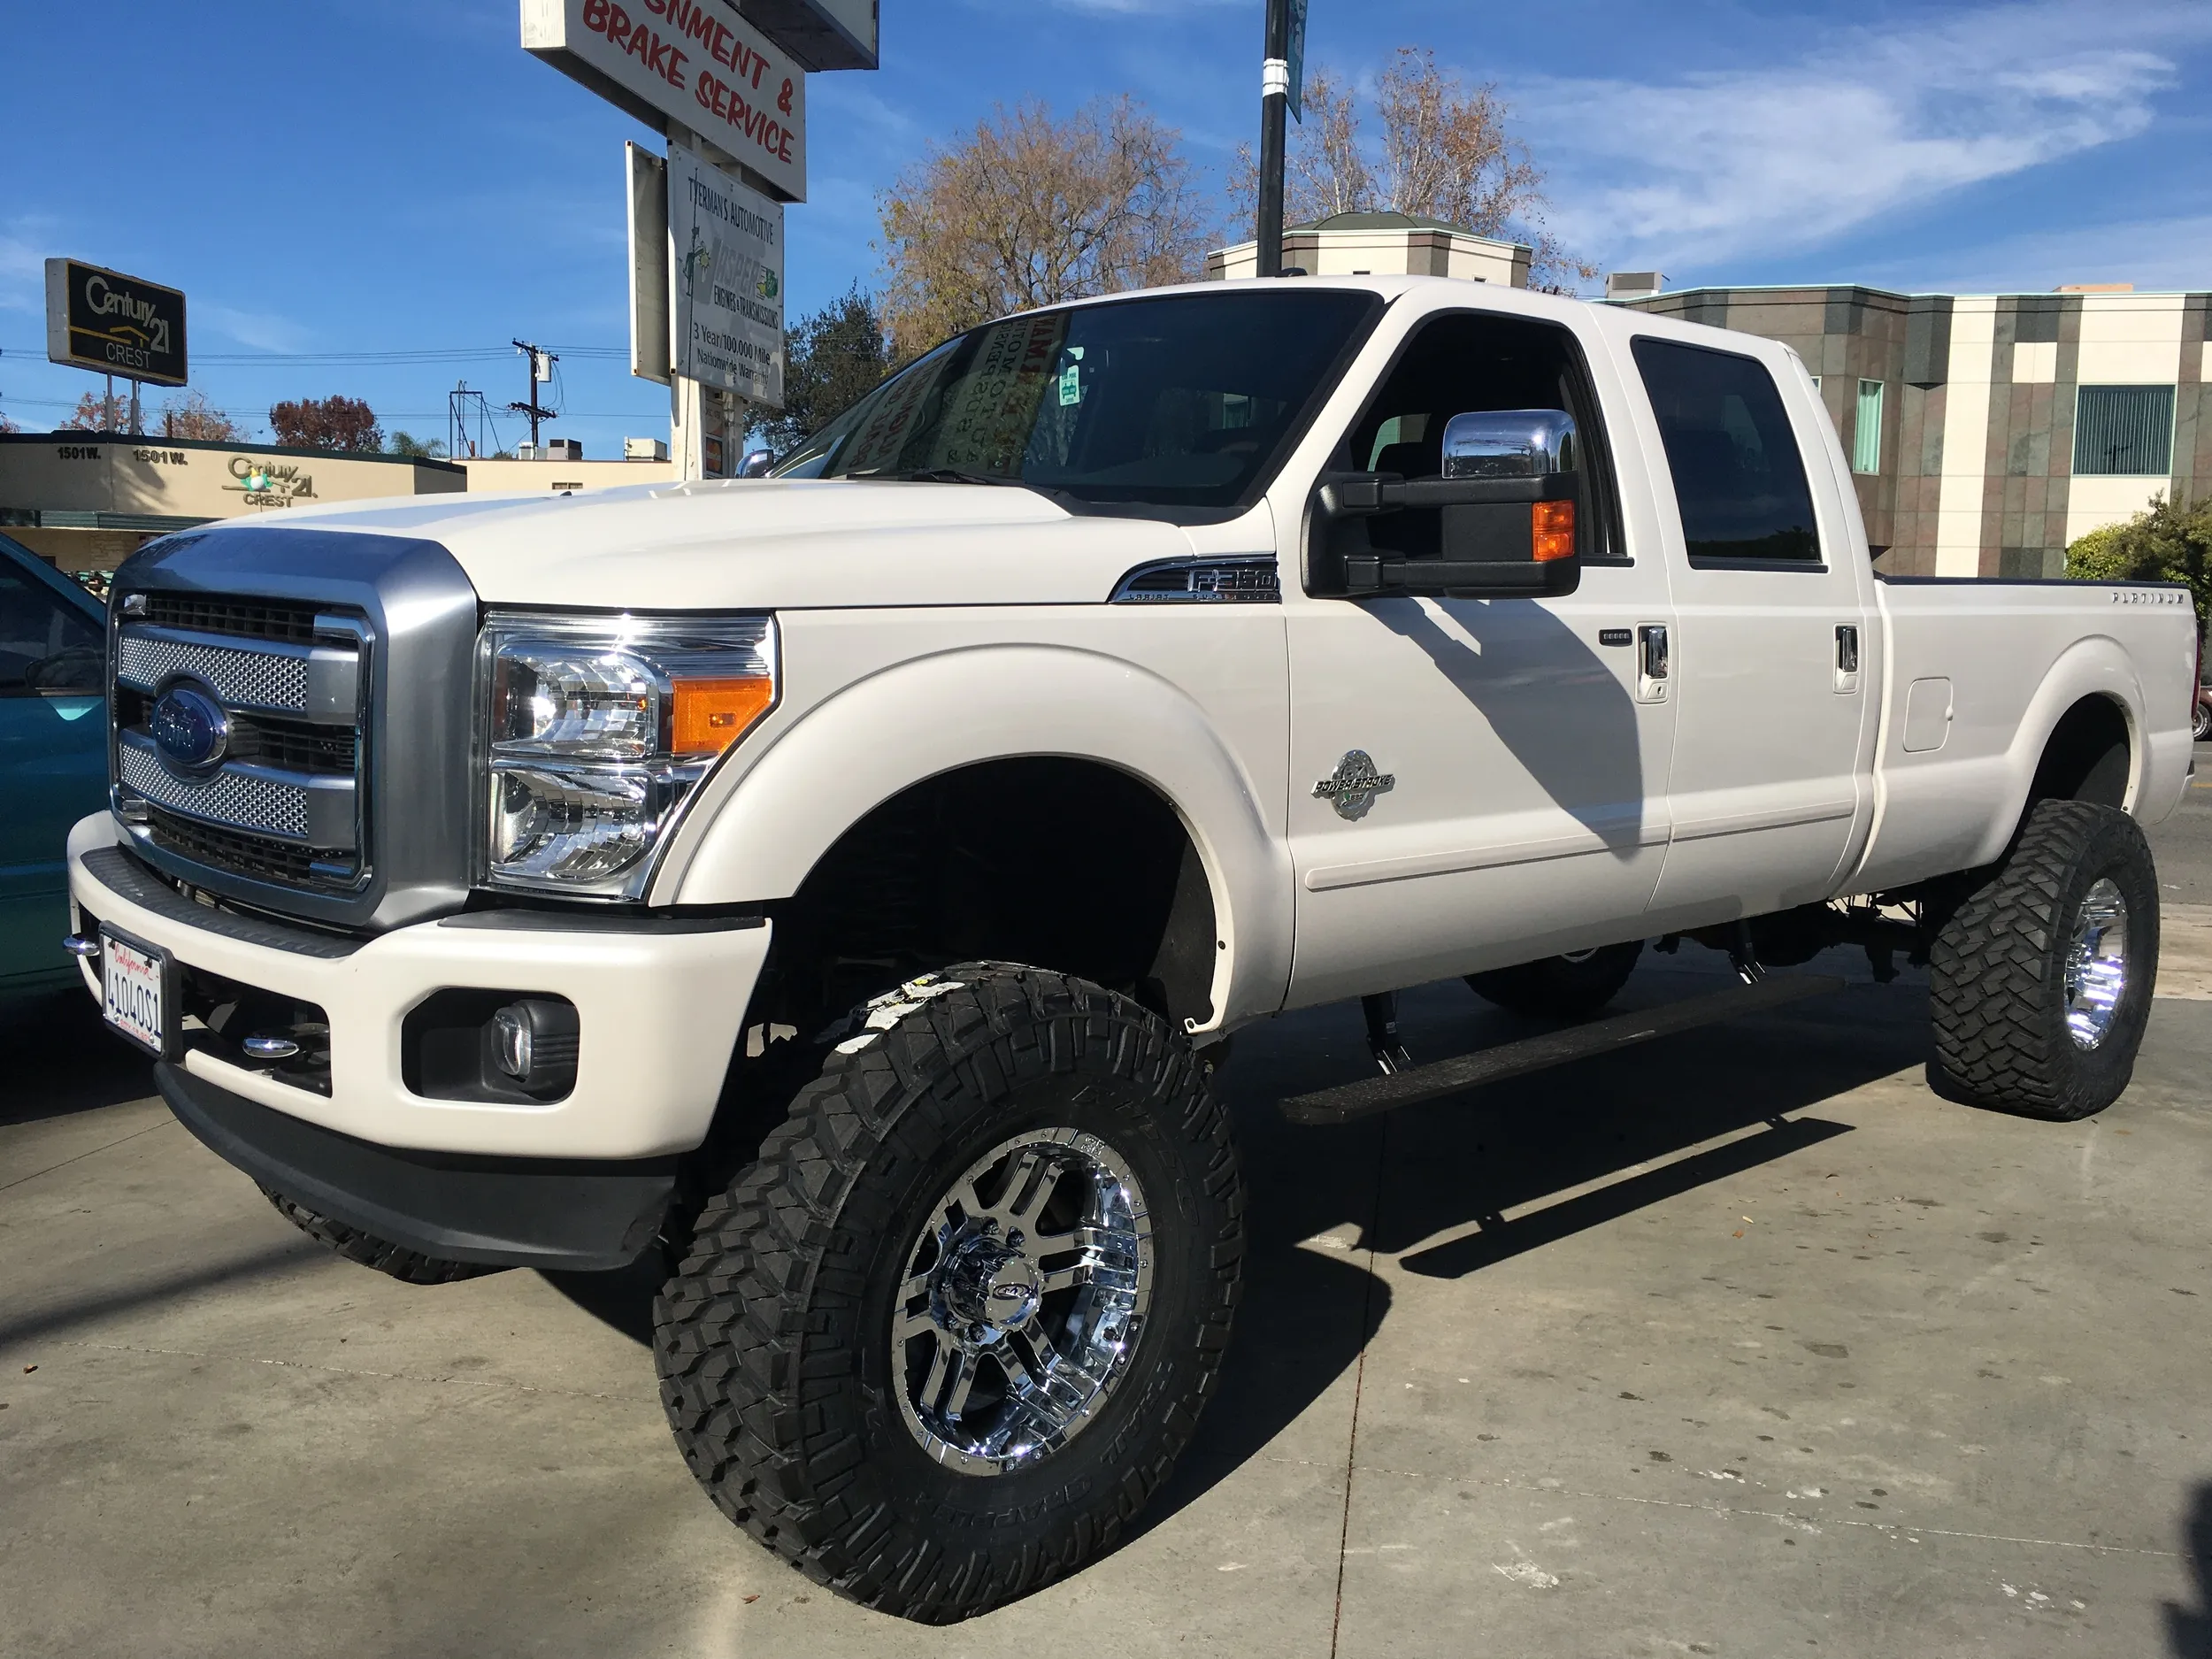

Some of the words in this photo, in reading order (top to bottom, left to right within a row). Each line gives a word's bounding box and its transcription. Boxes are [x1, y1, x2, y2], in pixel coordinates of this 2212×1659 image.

[582, 0, 689, 90] BRAKE
[695, 71, 795, 165] SERVICE
[777, 78, 793, 117] &
[730, 202, 773, 245] AUTOMOTIVE
[86, 275, 156, 327] Century
[150, 317, 170, 354] 21
[694, 322, 700, 340] 3
[755, 345, 771, 365] Mile
[105, 342, 151, 369] CREST
[697, 348, 737, 375] Nationwide
[58, 447, 85, 460] 1501
[134, 449, 168, 464] 1501
[242, 493, 294, 508] CREST
[2112, 592, 2185, 604] PLATINUM
[114, 941, 154, 981] California
